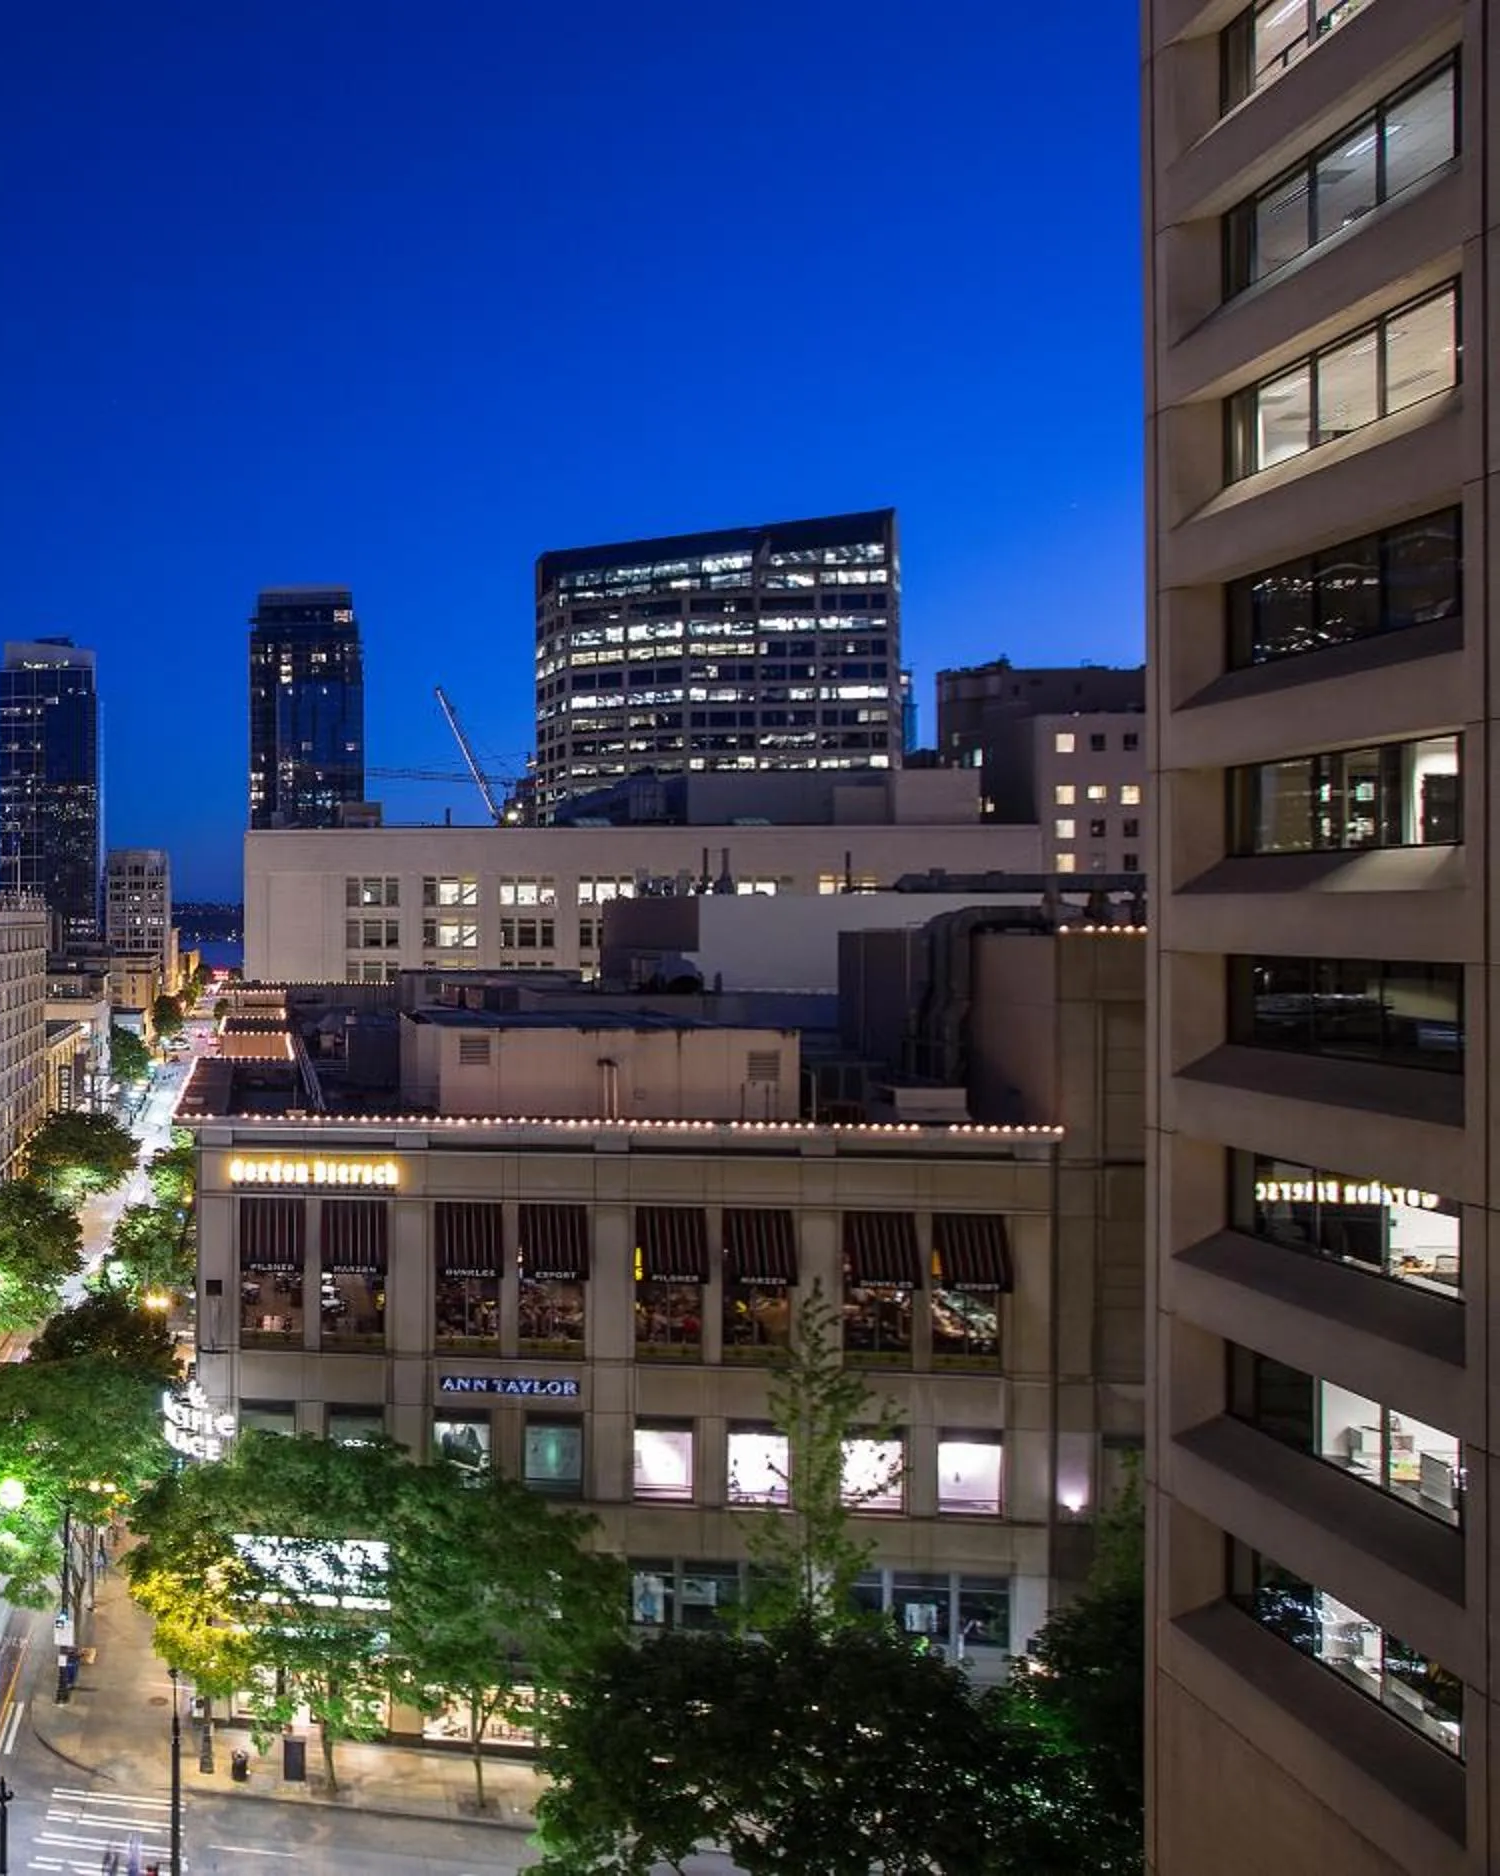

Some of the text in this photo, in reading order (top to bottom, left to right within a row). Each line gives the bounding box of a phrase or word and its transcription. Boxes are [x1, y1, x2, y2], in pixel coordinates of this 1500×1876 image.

[535, 1271, 578, 1279] EXPORT
[442, 1377, 578, 1395] ANN TAYLOR
